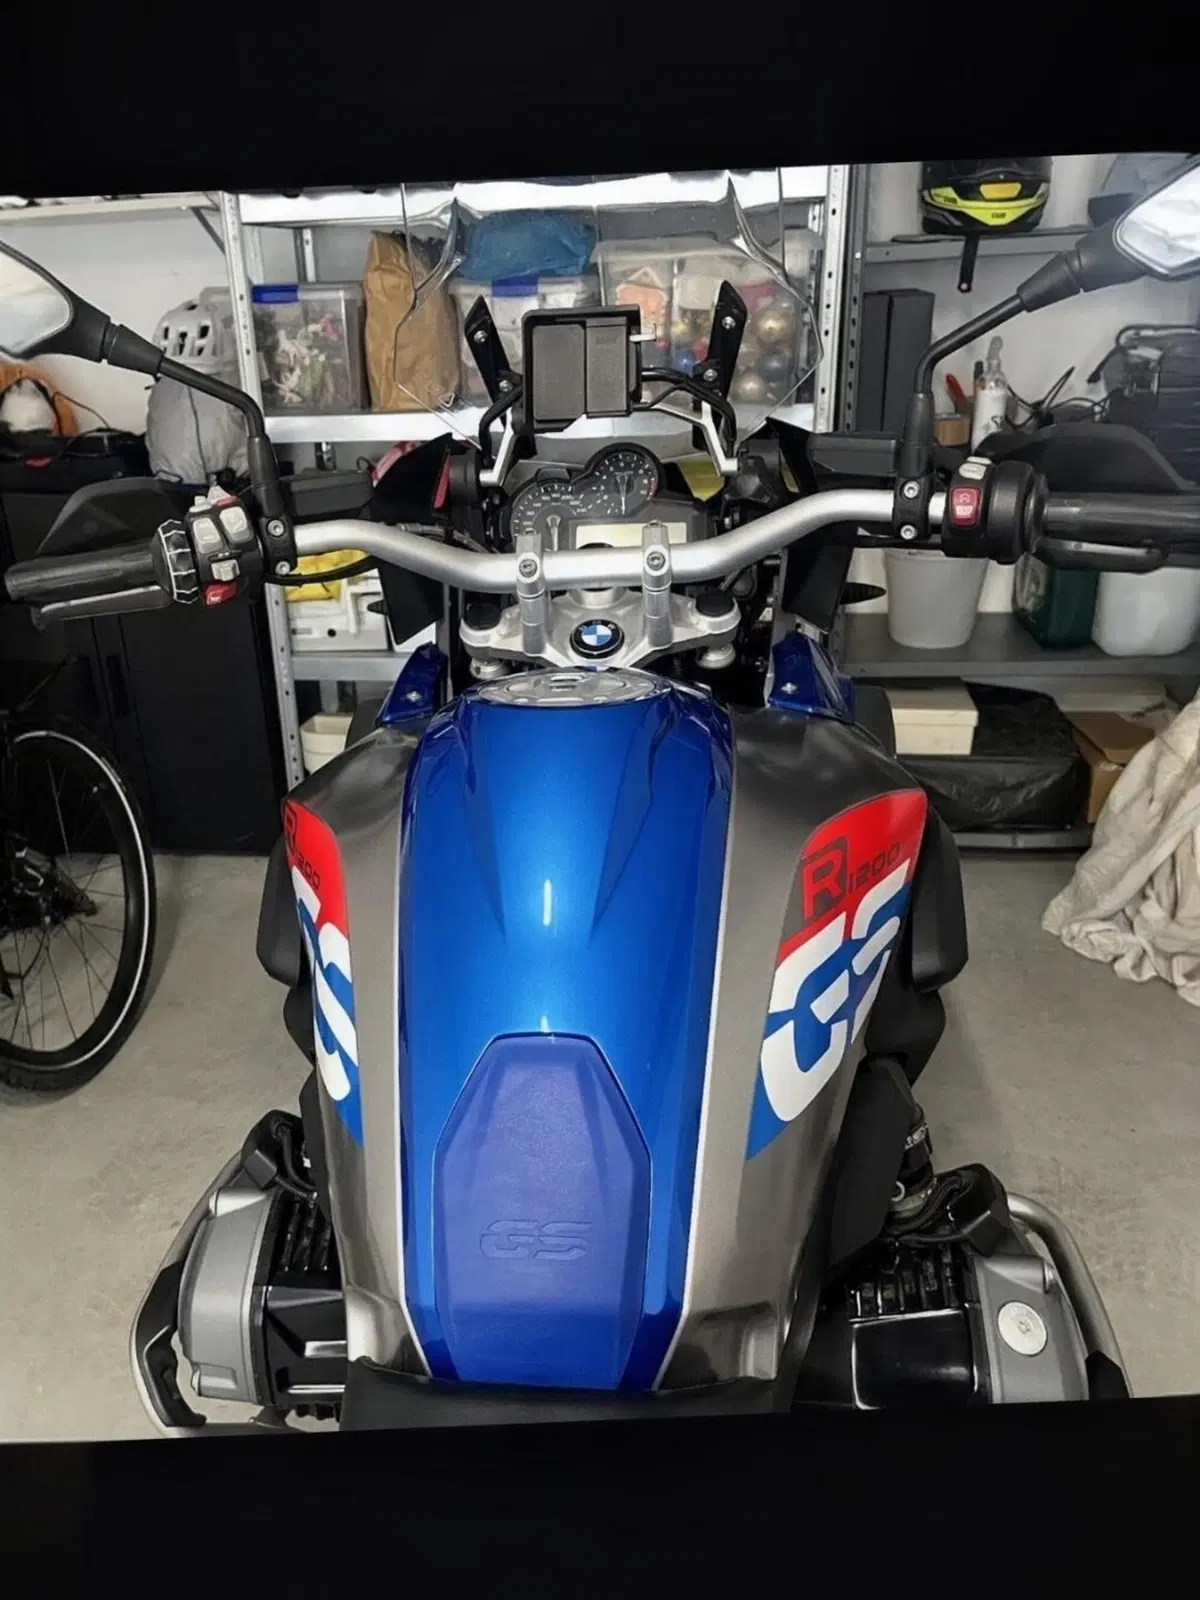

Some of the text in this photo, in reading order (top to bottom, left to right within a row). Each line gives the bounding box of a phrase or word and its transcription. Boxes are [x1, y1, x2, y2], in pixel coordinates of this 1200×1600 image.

[803, 842, 901, 920] R 1200
[760, 859, 911, 1122] GS
[479, 1219, 593, 1261] GS
